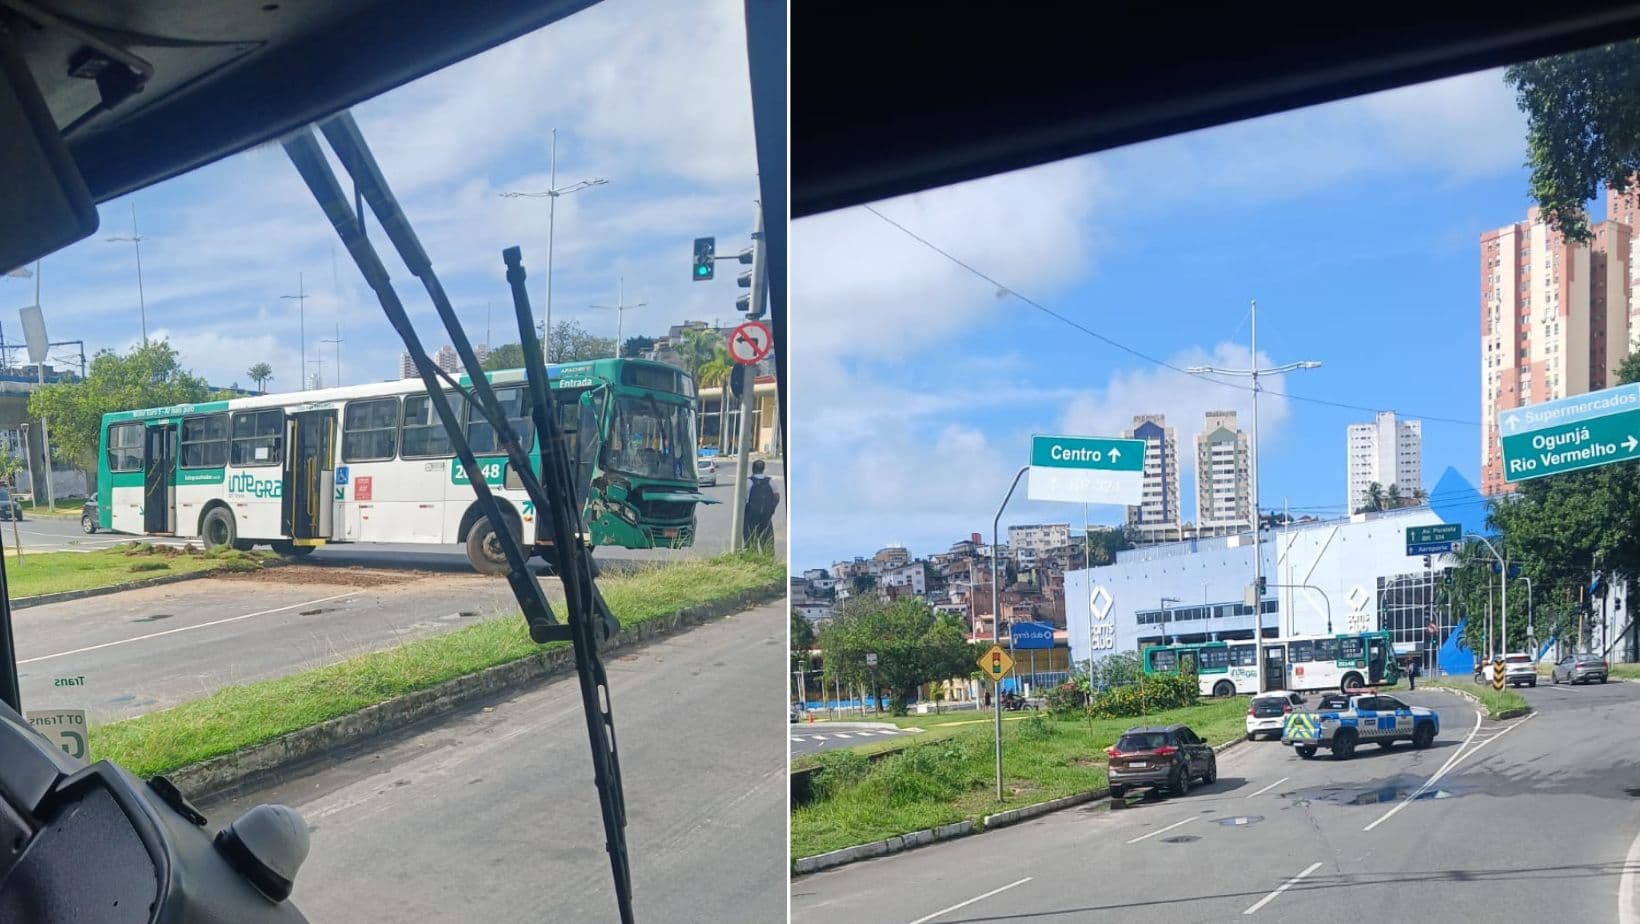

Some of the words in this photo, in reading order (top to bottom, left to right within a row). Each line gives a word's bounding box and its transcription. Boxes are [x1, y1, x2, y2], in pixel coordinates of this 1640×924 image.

[559, 377, 593, 389] Entrada
[1525, 393, 1637, 423] Supermercados
[1532, 426, 1590, 450] Ogunjá
[1051, 445, 1102, 462] Centro
[1510, 457, 1537, 473] Rio
[1541, 443, 1617, 467] Vermelho
[456, 463, 500, 479] 248
